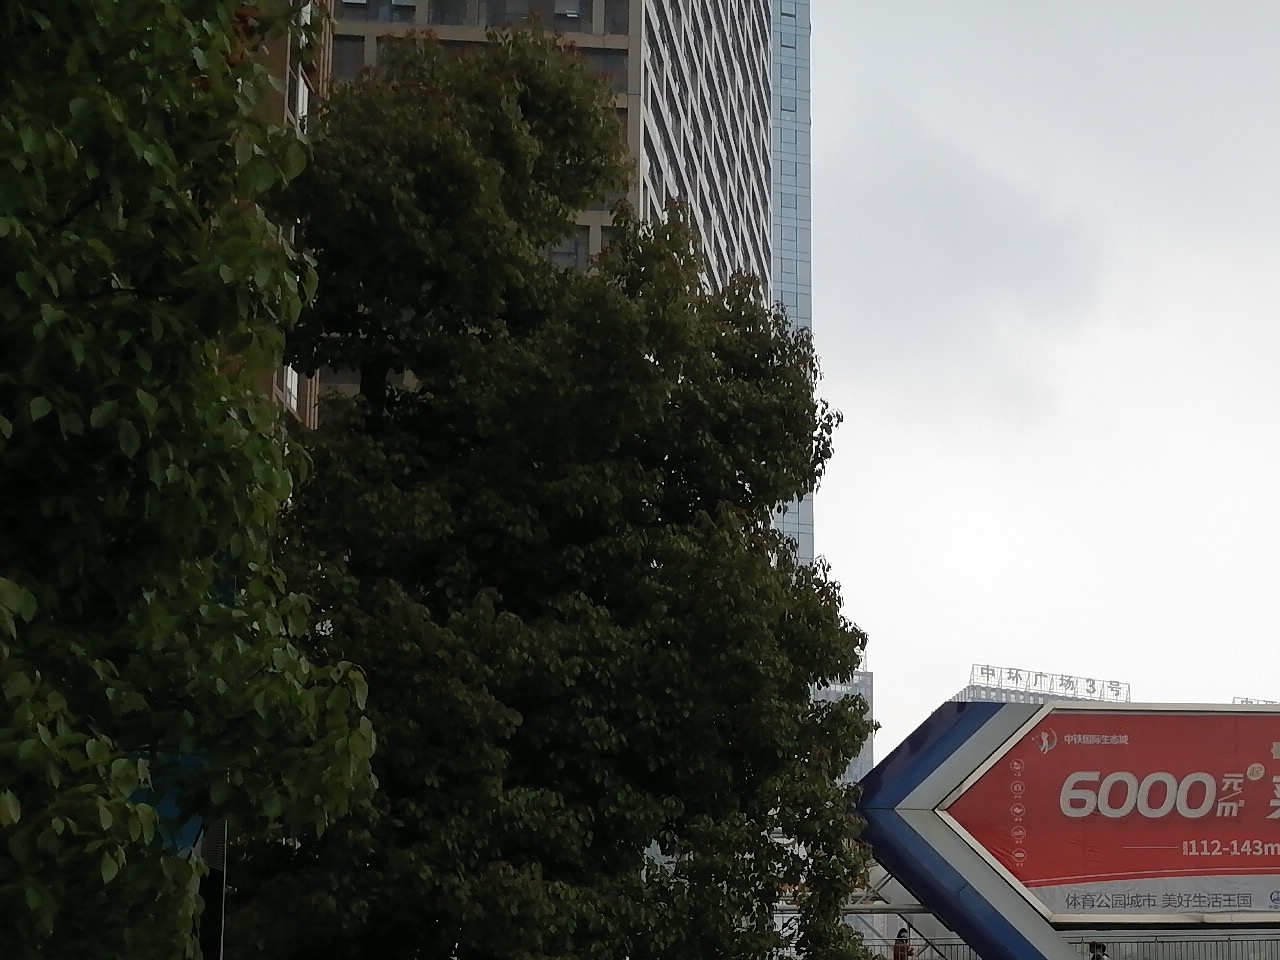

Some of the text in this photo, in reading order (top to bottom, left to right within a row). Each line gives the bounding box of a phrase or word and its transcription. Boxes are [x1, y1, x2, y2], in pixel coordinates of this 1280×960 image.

[980, 665, 1122, 697] 中环广场3号
[1060, 771, 1217, 818] 6000
[1064, 892, 1252, 910] 体育公园城市 美好生活王国
